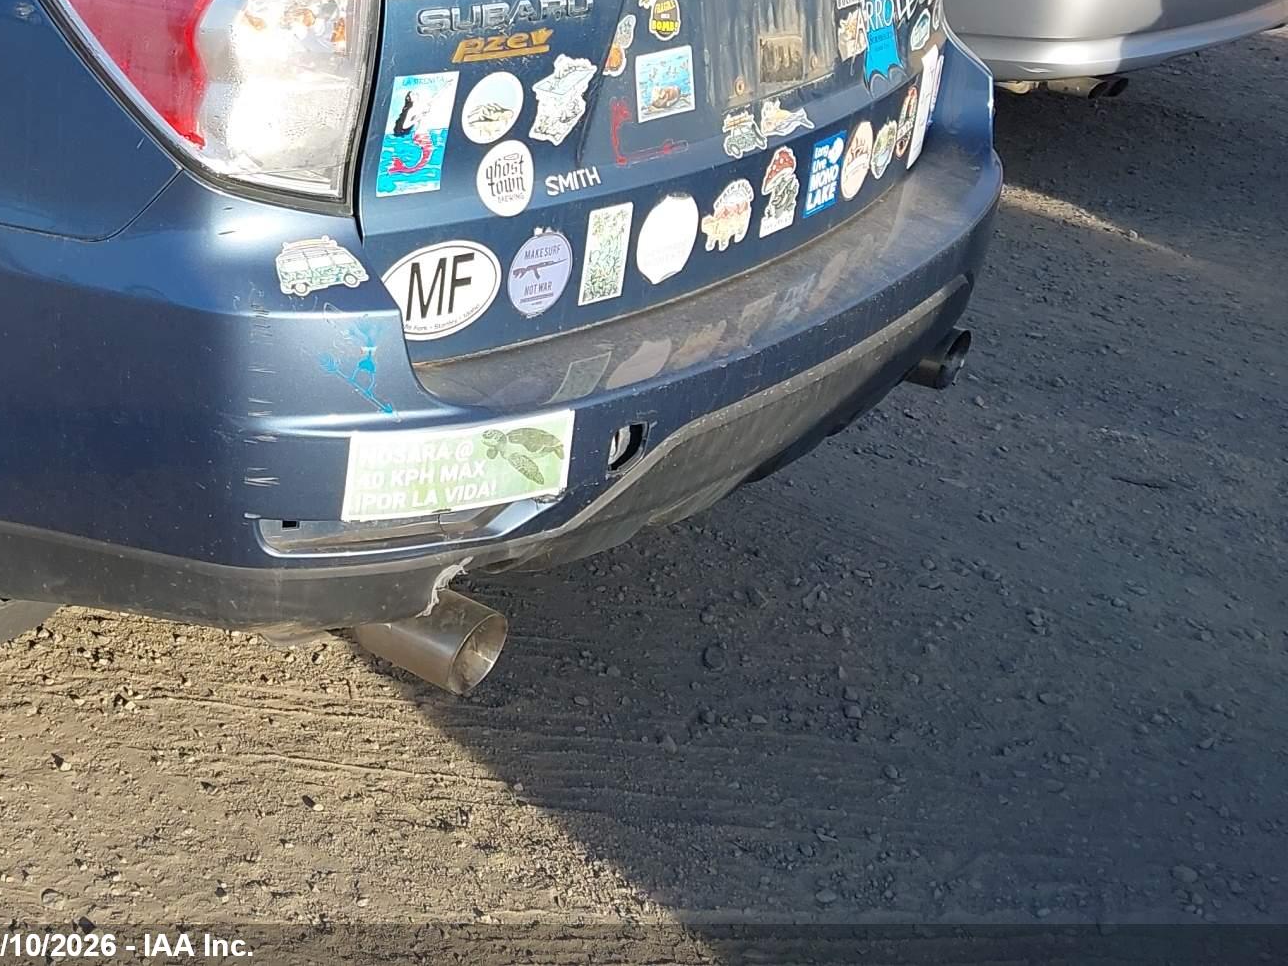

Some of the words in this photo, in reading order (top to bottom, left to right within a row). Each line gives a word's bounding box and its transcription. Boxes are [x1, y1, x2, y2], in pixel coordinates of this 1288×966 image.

[485, 154, 524, 180] ghost
[809, 164, 840, 191] MONO
[487, 176, 526, 197] town
[545, 166, 602, 196] SMITH
[806, 181, 838, 211] LAKE
[524, 247, 544, 260] MAKE
[544, 244, 562, 258] SURF
[405, 252, 475, 321] MF
[523, 283, 538, 297] NOT
[538, 281, 553, 293] WAR
[390, 465, 434, 487] KPH
[440, 459, 488, 483] MAX
[411, 488, 439, 507] LA
[445, 478, 497, 504] VIDA!
